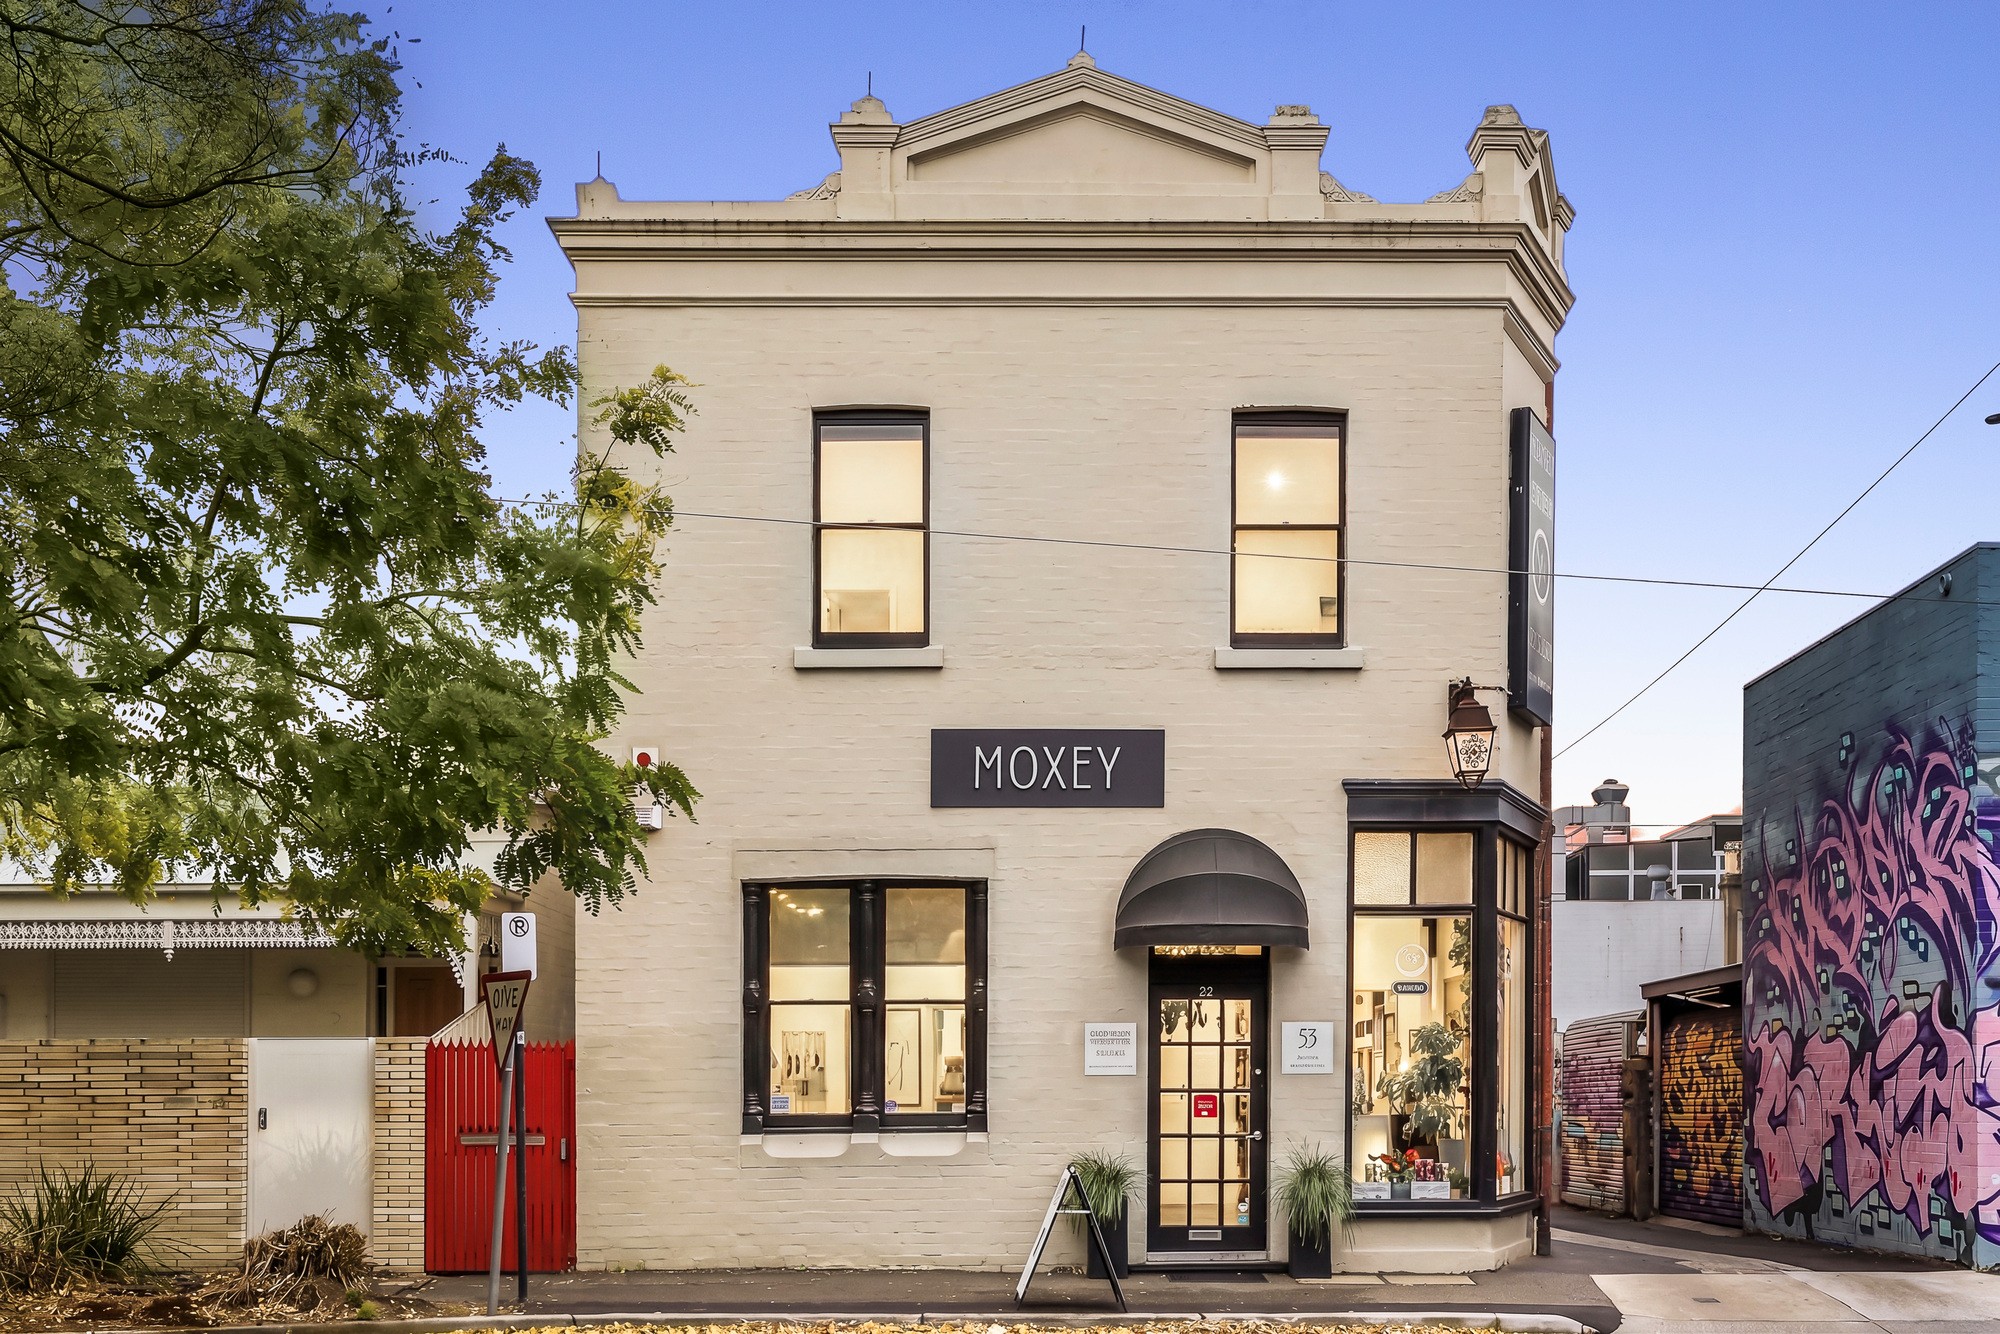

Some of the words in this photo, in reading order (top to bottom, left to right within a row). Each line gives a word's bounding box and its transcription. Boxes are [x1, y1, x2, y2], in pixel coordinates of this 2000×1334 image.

[974, 745, 1121, 789] MOXEY
[1199, 986, 1213, 997] 22
[495, 1016, 514, 1031] WAY
[1298, 1028, 1317, 1049] 53
